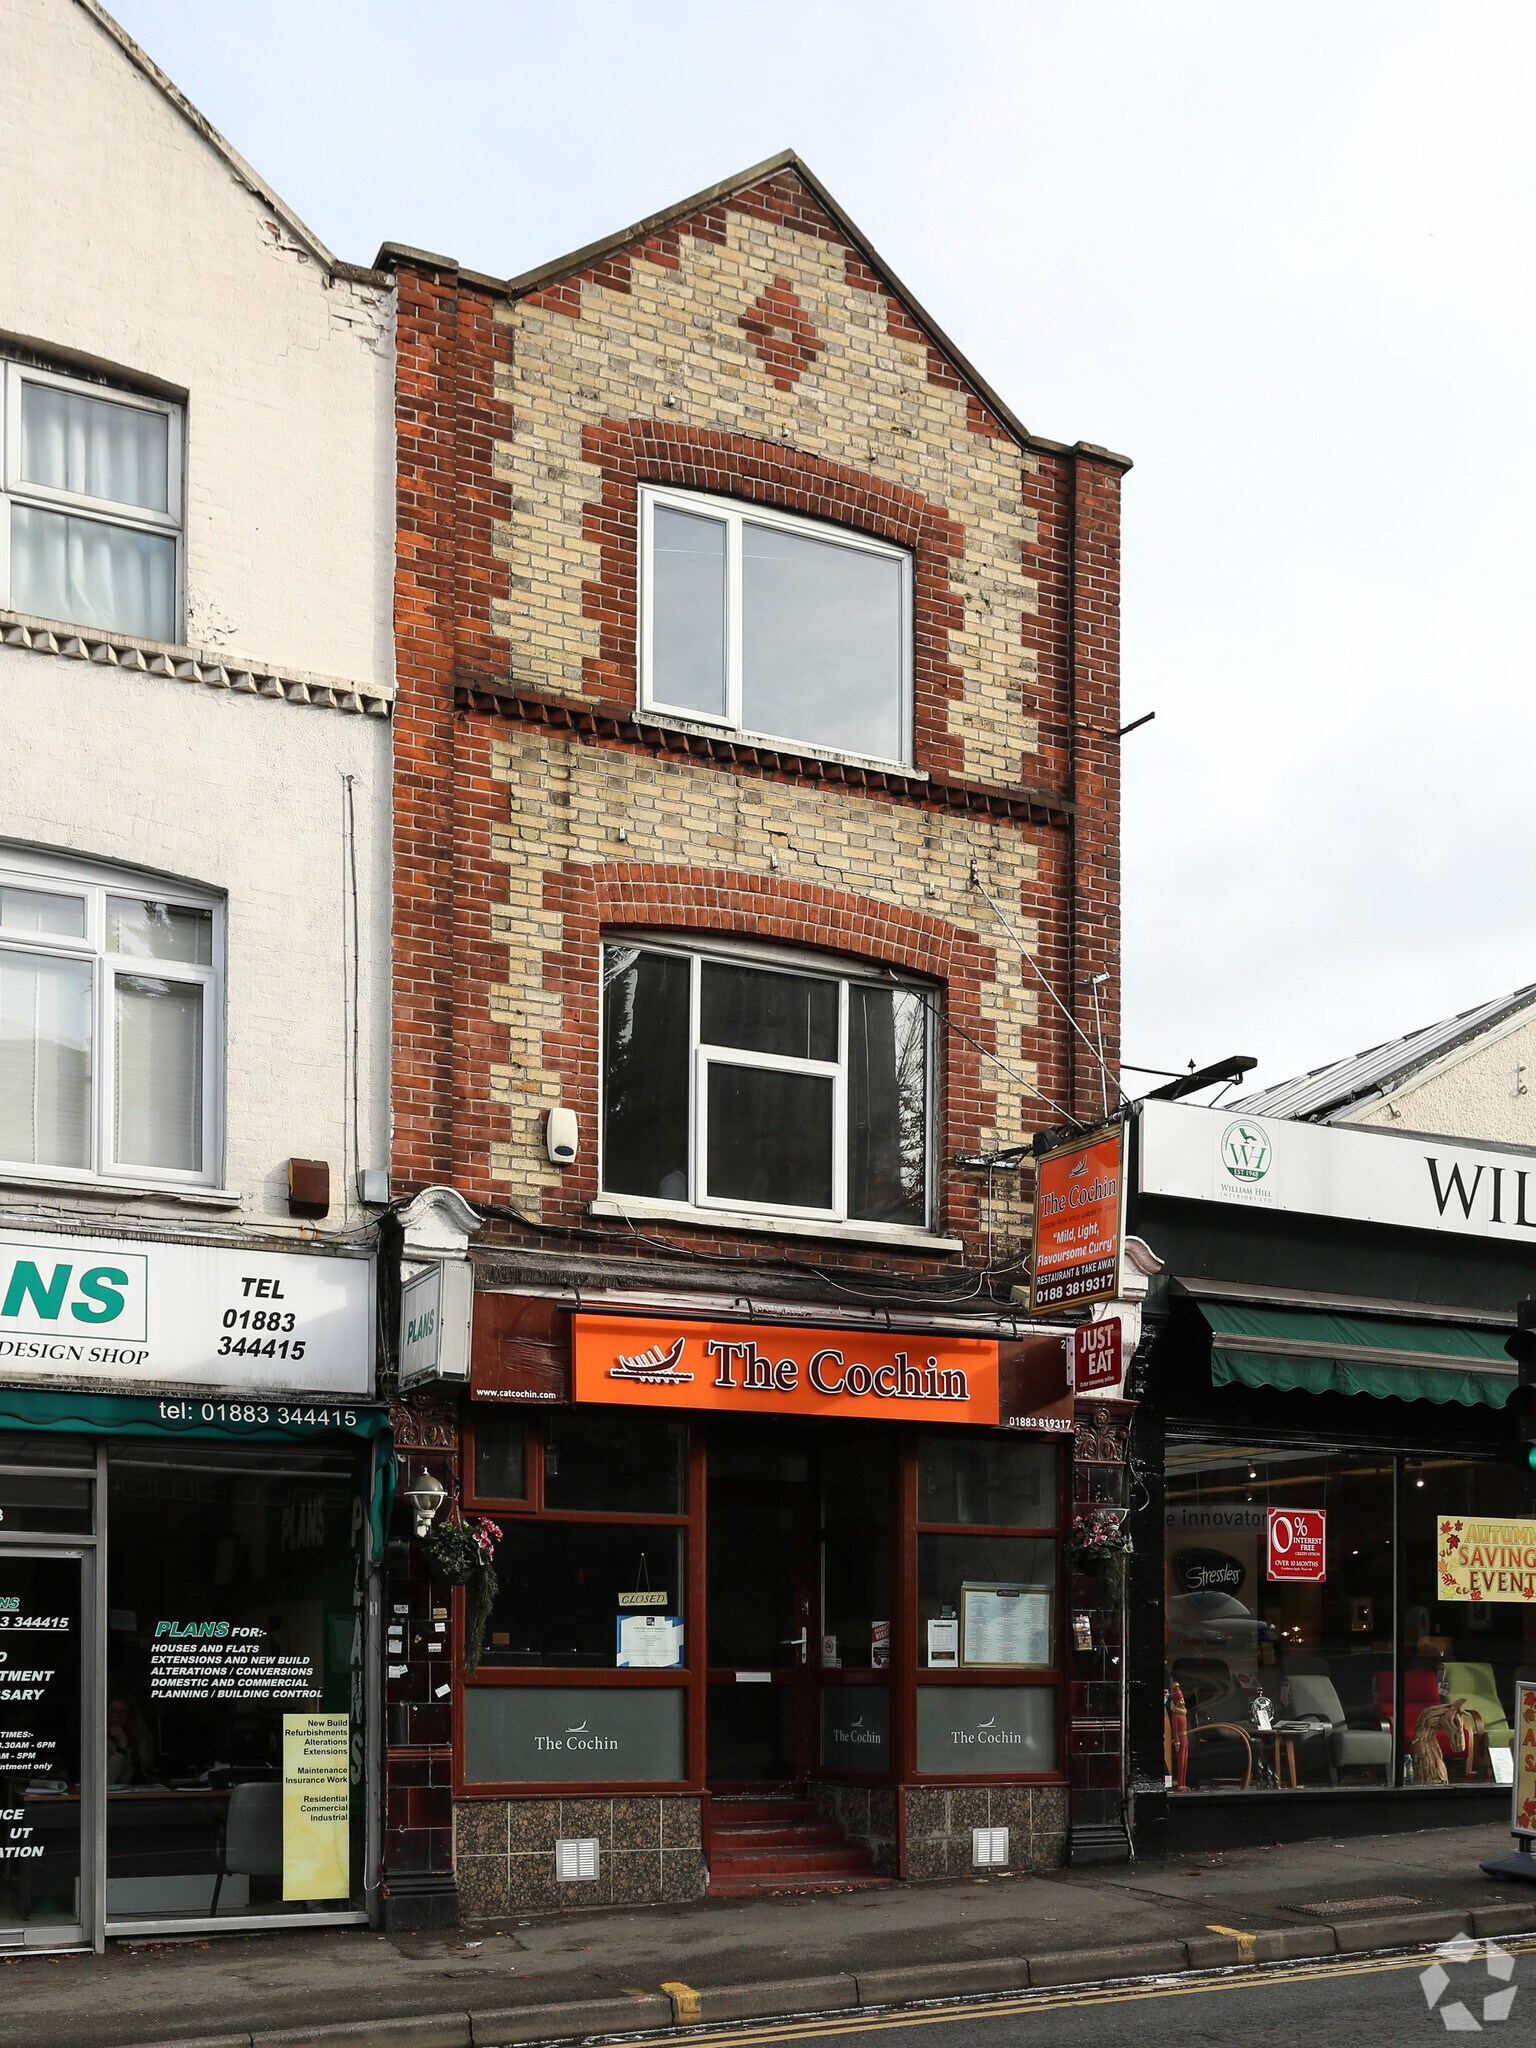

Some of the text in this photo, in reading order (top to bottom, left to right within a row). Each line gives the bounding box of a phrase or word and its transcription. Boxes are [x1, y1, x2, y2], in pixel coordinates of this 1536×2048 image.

[1041, 1176, 1117, 1217] The Cochin
[1220, 1192, 1257, 1200] INTERIORS
[1255, 1188, 1272, 1197] HILL
[1077, 1221, 1100, 1240] Light,
[1037, 1246, 1087, 1267] Flavoursome
[1037, 1258, 1116, 1286] RESTAURANT & TAKE AWAY
[241, 1277, 285, 1299] TEL
[1036, 1273, 1114, 1303] 0188 3819317
[222, 1309, 296, 1332] 01883
[407, 1309, 435, 1346] PLANS
[1080, 1324, 1114, 1353] JUST
[0, 1341, 149, 1365] DESIGN SHOP
[217, 1336, 306, 1360] 344415
[1088, 1348, 1114, 1375] EAT
[707, 1339, 971, 1401] The Cochin
[476, 1389, 556, 1399] www.catcochin.com
[159, 1401, 357, 1427] tel: 01883 344415
[1009, 1417, 1072, 1429] 01883 819317
[1293, 1537, 1322, 1545] INTEREST
[1300, 1544, 1315, 1552] FREE
[1459, 1545, 1536, 1569] SAVING
[1185, 1562, 1241, 1589] Stressless
[1469, 1570, 1536, 1593] EVENT
[622, 1594, 665, 1604] CLOSED
[13, 1617, 70, 1628] 344415
[155, 1621, 229, 1638] PLANS
[151, 1644, 259, 1653] HOUSES AND FLATS
[151, 1656, 222, 1664] EXTENSIONS
[224, 1656, 248, 1664] AND
[278, 1657, 310, 1665] BUILD
[150, 1667, 227, 1675] ALTERATIONS
[236, 1667, 313, 1676] CONVERSIONS
[151, 1678, 309, 1687] DOMESTIC AND COMMERCIAL
[0, 1689, 45, 1700] SARY
[151, 1690, 209, 1698] PLANNING
[217, 1690, 270, 1698] BUILDING
[272, 1690, 323, 1698] CONTROL
[327, 1719, 348, 1727] Build
[304, 1738, 348, 1746] Alterations
[833, 1729, 881, 1744] The Cochin
[951, 1731, 1021, 1744] The Cochin
[36, 1741, 56, 1749] 6PM
[535, 1736, 618, 1750] The Cochin
[16, 1752, 36, 1760] 5PM
[303, 1748, 348, 1756] Extensions
[33, 1762, 53, 1771] only
[303, 1795, 348, 1803] Residential
[300, 1804, 348, 1812] Commercial
